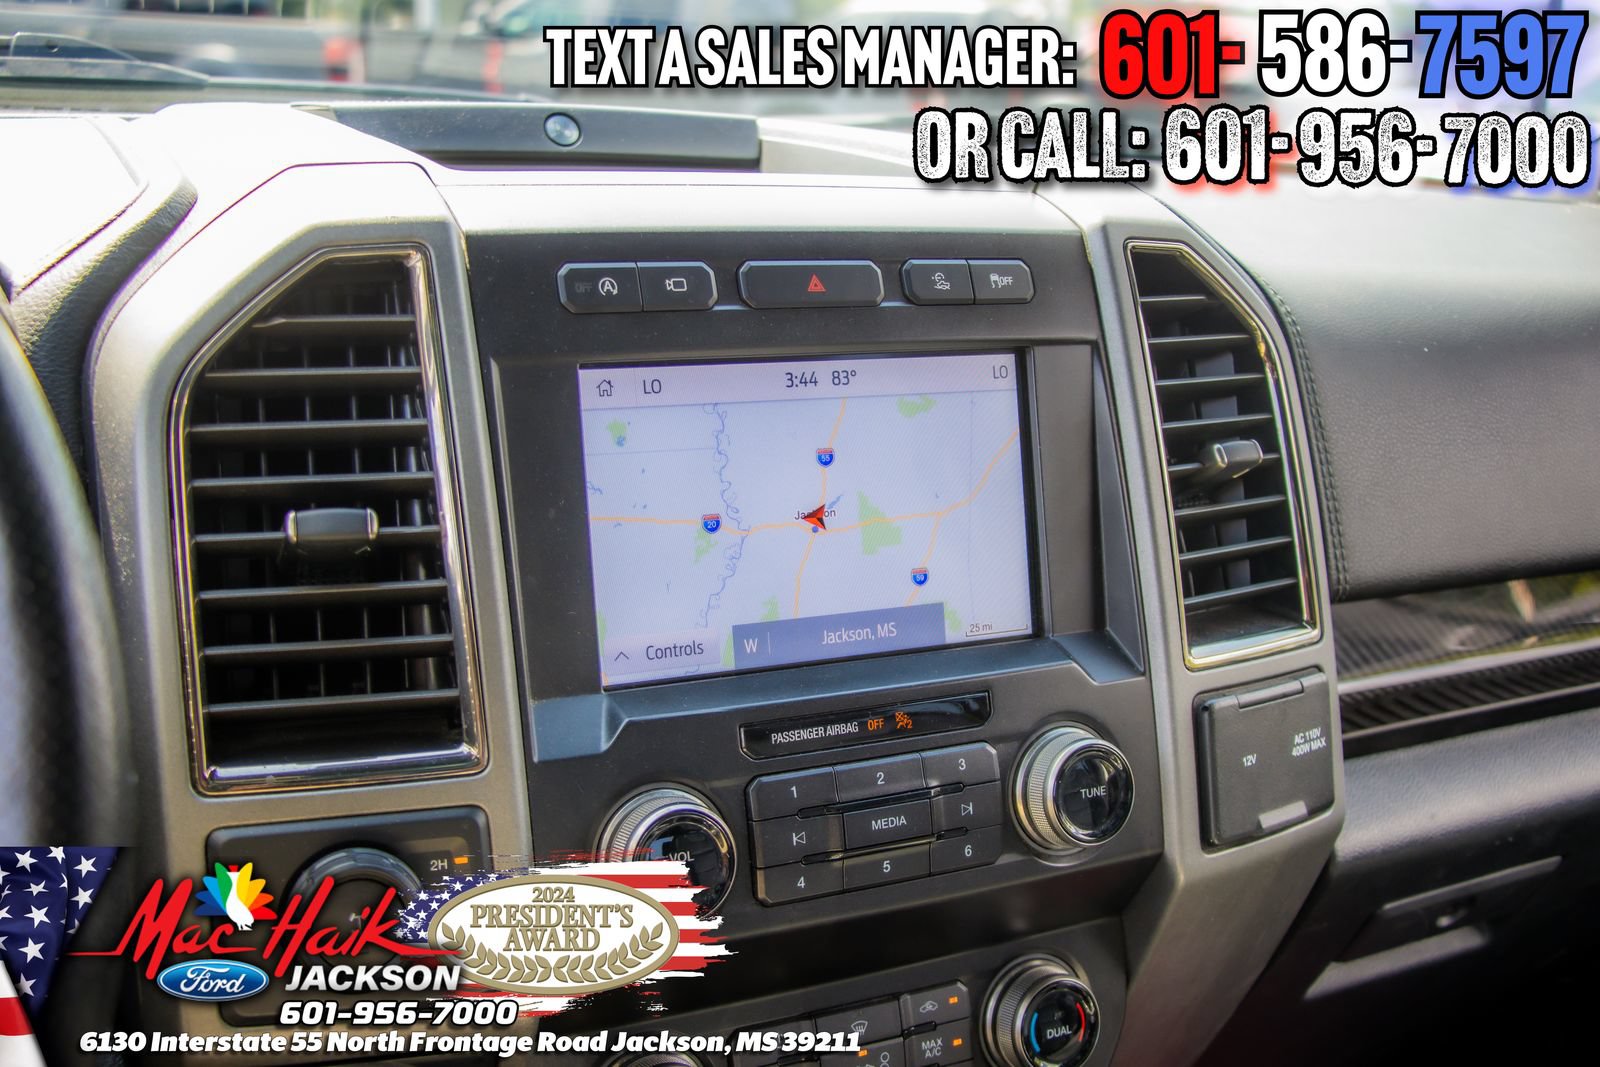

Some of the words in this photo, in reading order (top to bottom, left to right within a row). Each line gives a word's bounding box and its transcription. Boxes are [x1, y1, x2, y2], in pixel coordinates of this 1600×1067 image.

[999, 276, 1013, 286] OFF
[992, 364, 1009, 379] LO
[785, 371, 818, 389] 3:44
[831, 370, 857, 386] 83°
[643, 379, 662, 395] LO
[820, 453, 831, 463] 55
[707, 519, 717, 530] 20
[915, 573, 925, 581] 59
[821, 625, 876, 646] Jackson,
[877, 621, 897, 639] MS
[969, 623, 981, 634] 25
[982, 623, 993, 632] mi
[645, 640, 705, 661] Controls
[744, 638, 759, 654] W
[771, 729, 825, 745] PASSENGER
[826, 721, 860, 737] AIRBAG
[867, 719, 885, 731] OFF
[1295, 732, 1305, 745] AC
[1305, 727, 1322, 740] 110V
[1291, 742, 1311, 758] 400W
[1311, 736, 1327, 750] MAX
[958, 758, 966, 770] 3
[1242, 753, 1257, 767] 12V
[876, 772, 885, 785] 2
[790, 785, 798, 798] 1
[1080, 785, 1107, 799] TUNE
[871, 815, 907, 831] MEDIA
[669, 851, 695, 861] VOL
[964, 844, 973, 857] 6
[430, 859, 448, 871] 2H
[882, 860, 891, 873] 5
[797, 875, 806, 889] 4
[1046, 1025, 1072, 1039] DUAL
[921, 1037, 943, 1050] MAX
[924, 1048, 942, 1058] A/C
